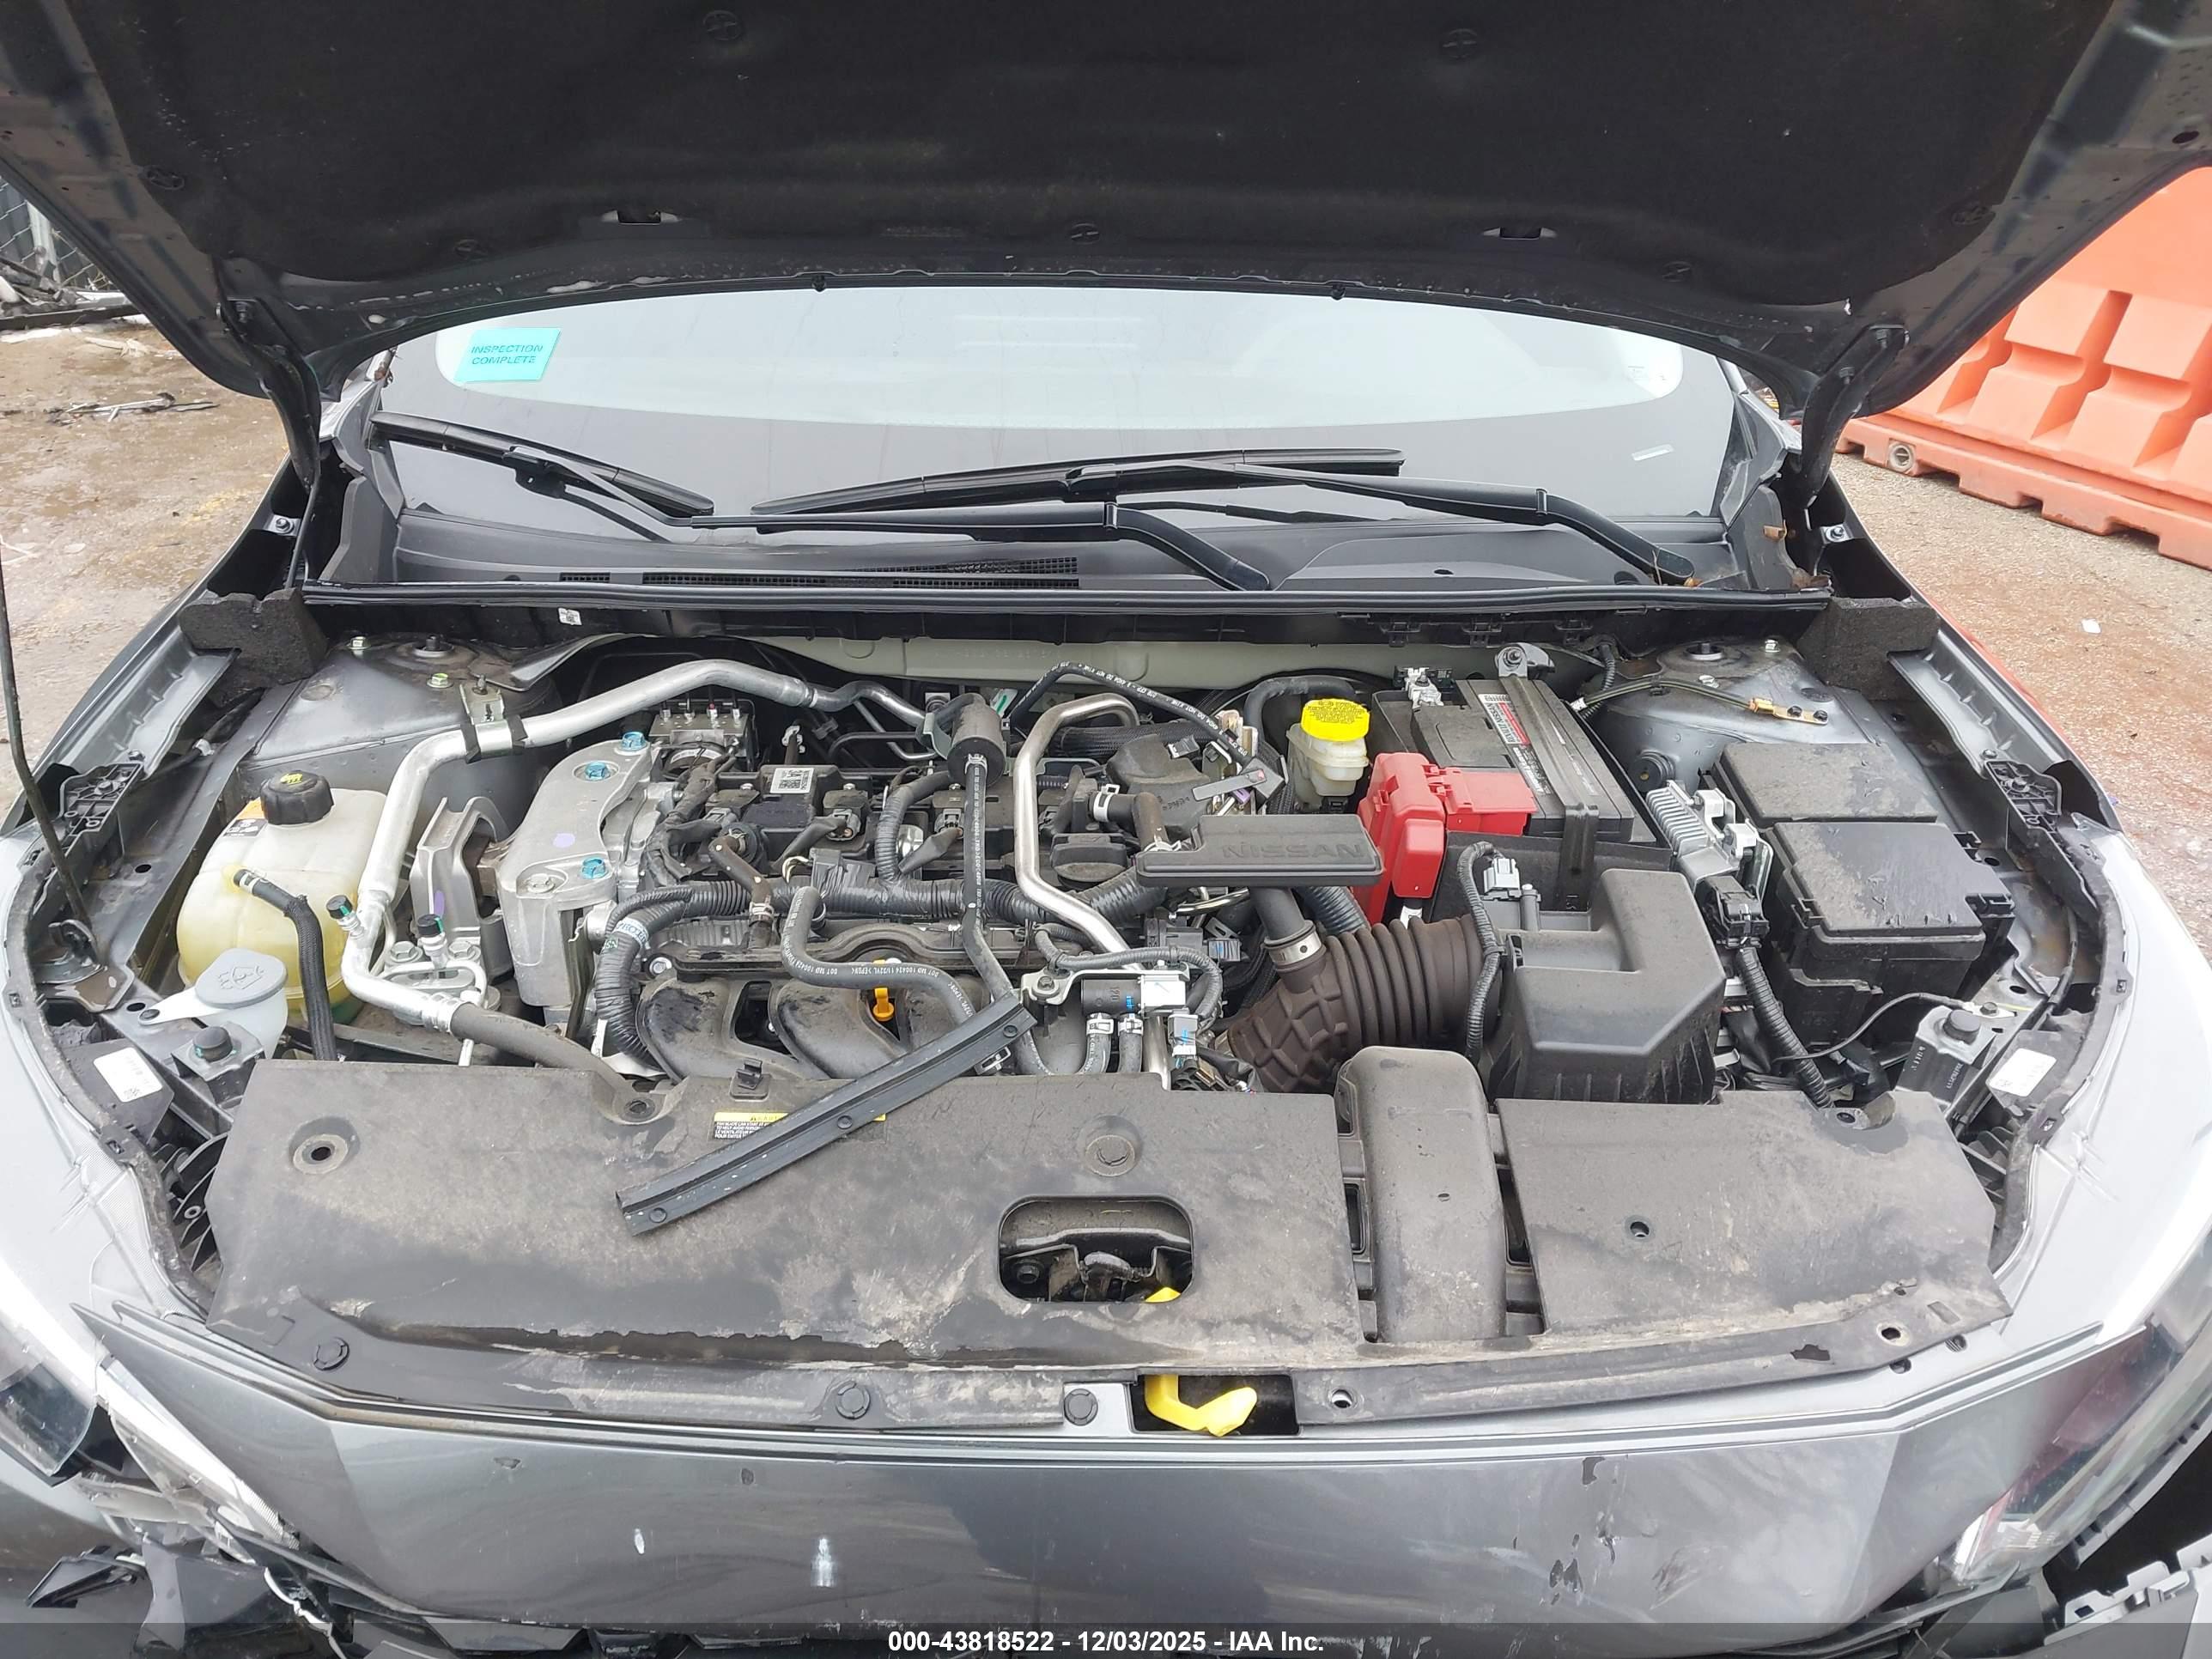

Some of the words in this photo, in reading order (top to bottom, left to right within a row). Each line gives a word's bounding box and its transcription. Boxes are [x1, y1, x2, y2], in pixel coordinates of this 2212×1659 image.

[471, 344, 544, 354] INSPECTION
[471, 356, 537, 365] COMPLETE
[1222, 843, 1364, 859] NISSAN
